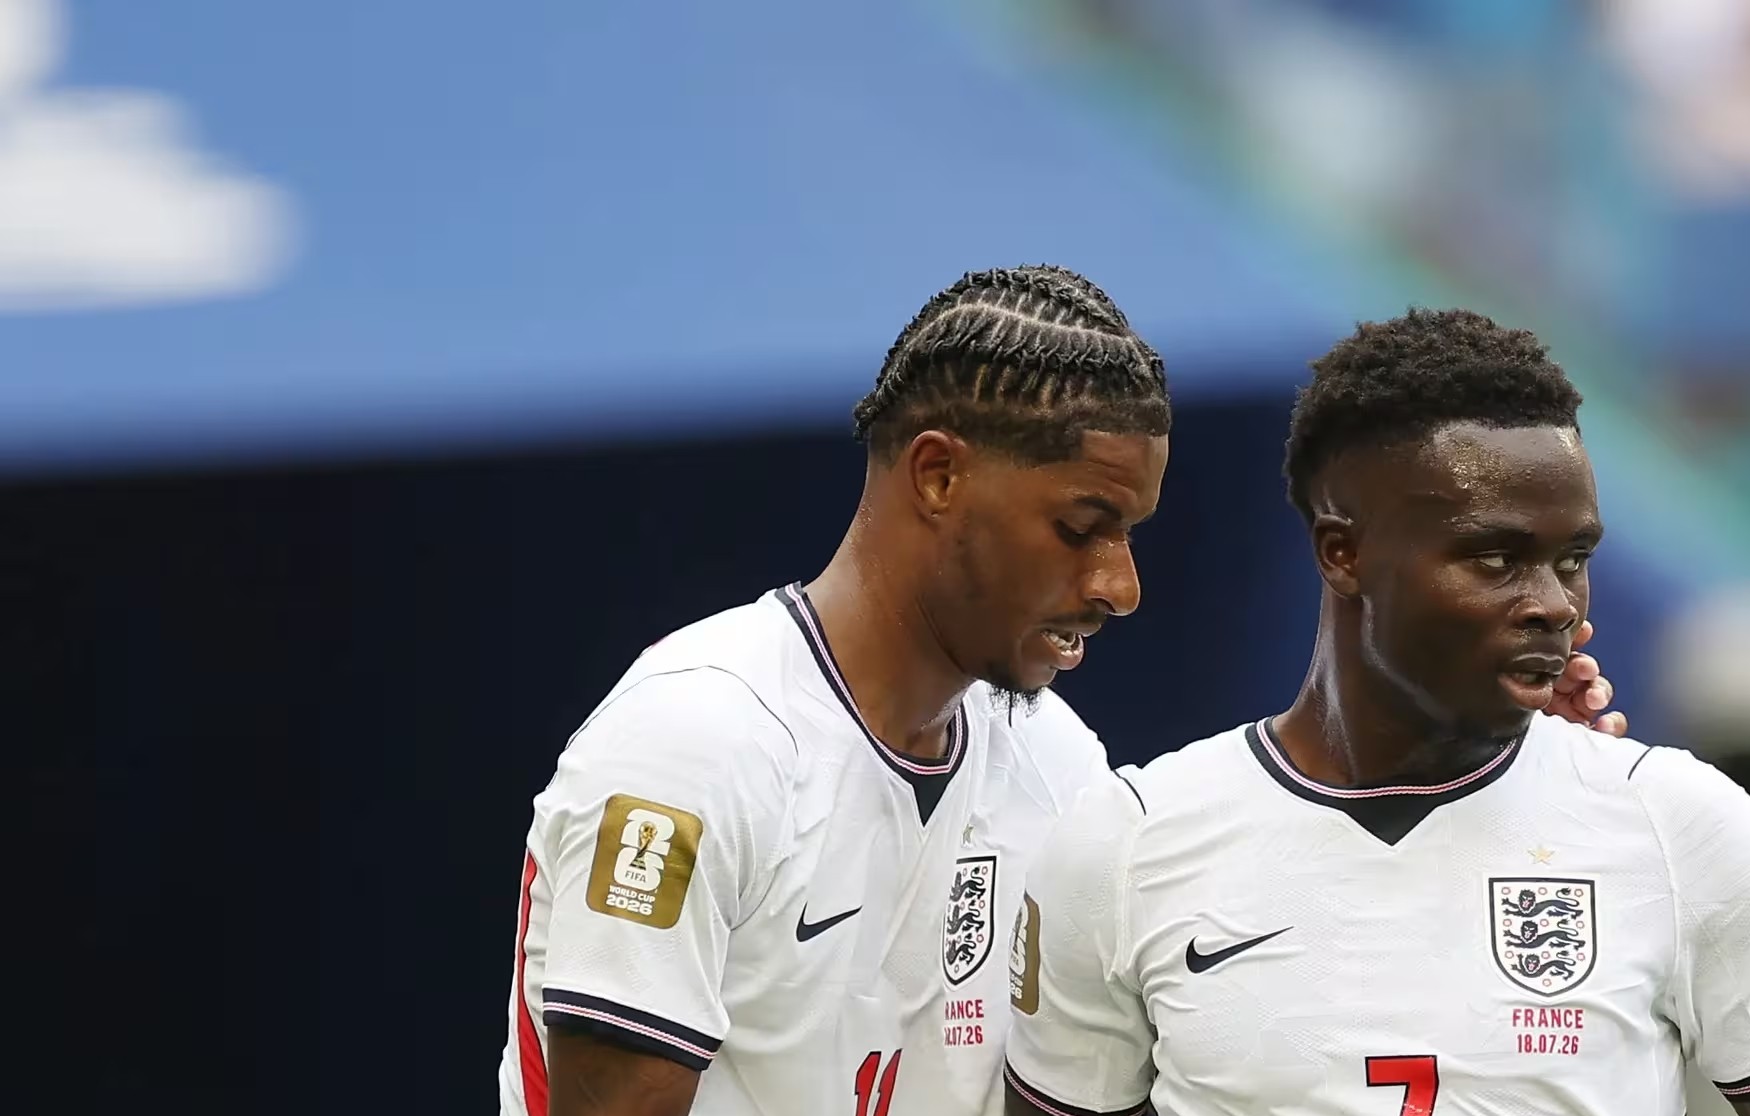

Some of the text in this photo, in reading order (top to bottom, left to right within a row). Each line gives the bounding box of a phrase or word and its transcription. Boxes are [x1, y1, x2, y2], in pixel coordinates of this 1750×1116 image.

[624, 870, 647, 883] FIFA
[609, 885, 656, 903] WORLD CUP
[605, 894, 653, 916] 2026
[945, 999, 984, 1020] RANCE
[1512, 1008, 1584, 1029] FRANCE
[1517, 1033, 1579, 1055] 18.07.26
